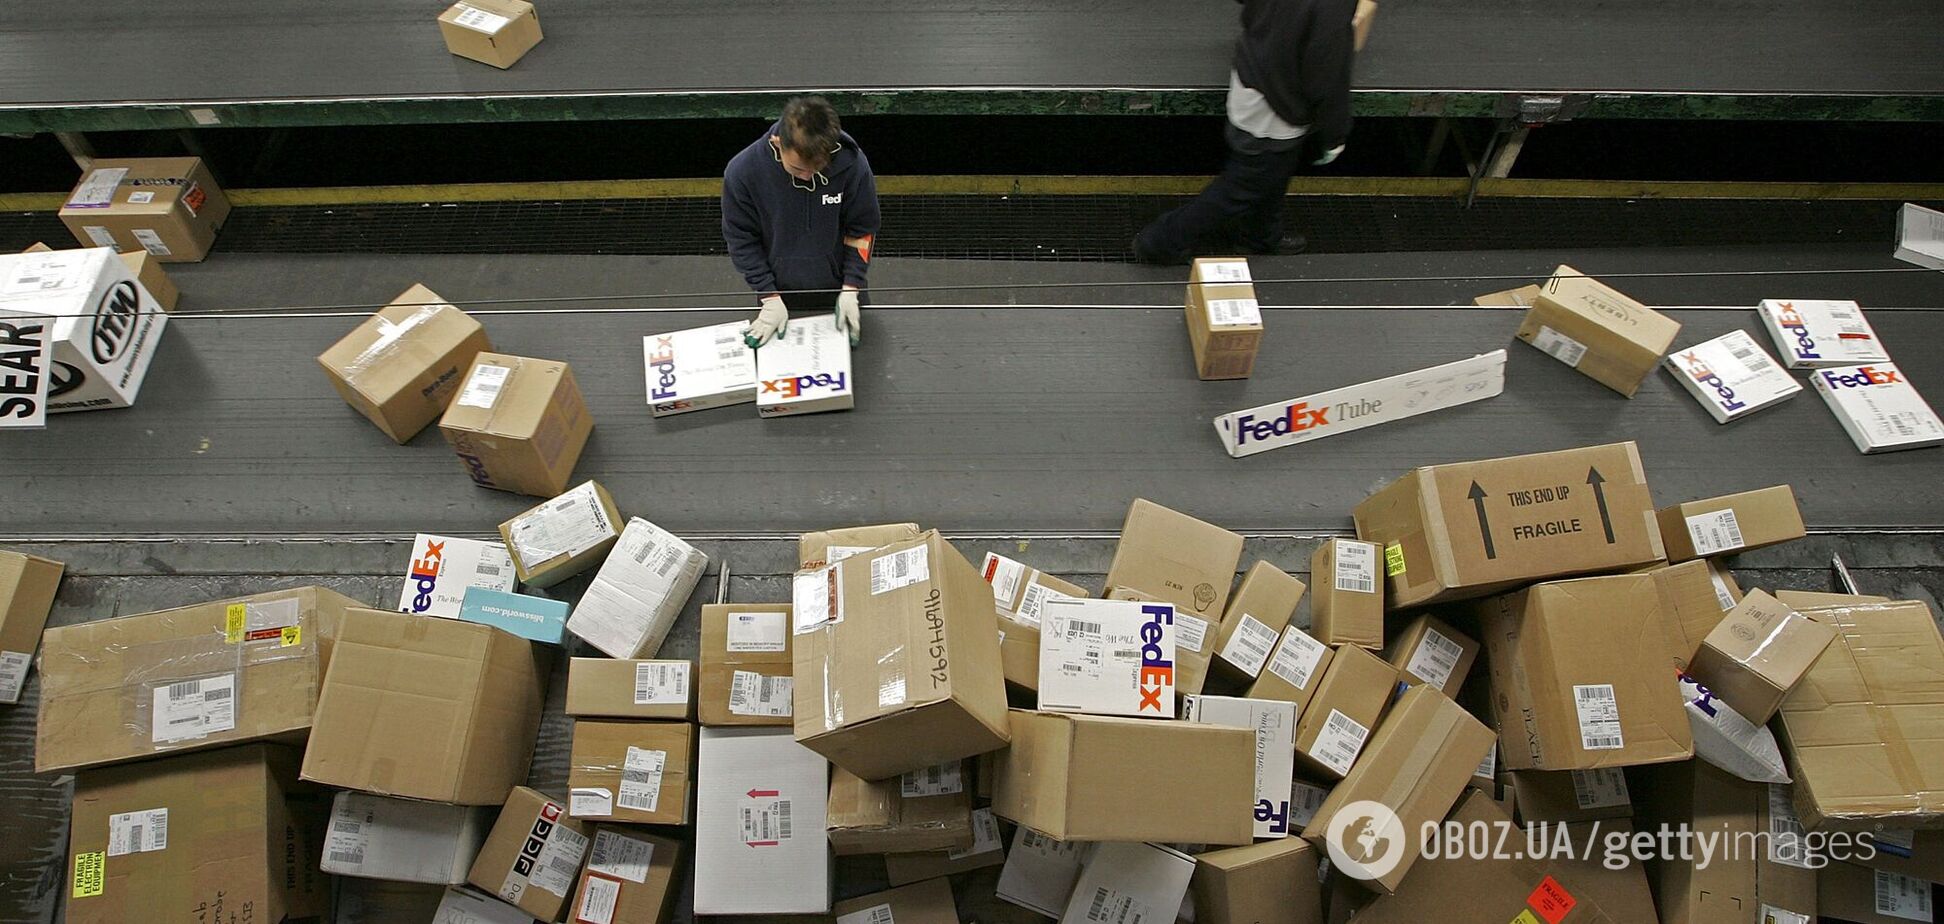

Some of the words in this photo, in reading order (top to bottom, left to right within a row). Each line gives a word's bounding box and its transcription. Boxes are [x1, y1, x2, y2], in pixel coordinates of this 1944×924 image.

[95, 287, 136, 356] JTM
[1776, 302, 1821, 359] FedEx
[650, 335, 677, 400] FedEx
[1822, 366, 1902, 390] FedEx
[761, 372, 845, 398] FedEx
[1680, 351, 1746, 412] FedEx
[655, 401, 692, 413] FedEx
[1237, 402, 1330, 446] FedEx
[1335, 398, 1382, 422] Tube
[1507, 491, 1533, 507] THIS
[1534, 488, 1555, 504] END
[1556, 486, 1570, 500] UP
[1513, 518, 1582, 541] FRAGILE
[402, 539, 445, 614] edEx
[481, 604, 545, 624] blissworld.com
[1118, 634, 1134, 644] The
[1139, 605, 1174, 713] FedEx
[1257, 737, 1265, 749] On
[286, 825, 296, 841] UP
[286, 843, 296, 864] END
[76, 854, 86, 888] FRAGILE
[84, 853, 93, 894] ELECTRON
[286, 865, 296, 889] THIS
[1542, 883, 1568, 908] FRAGILE
